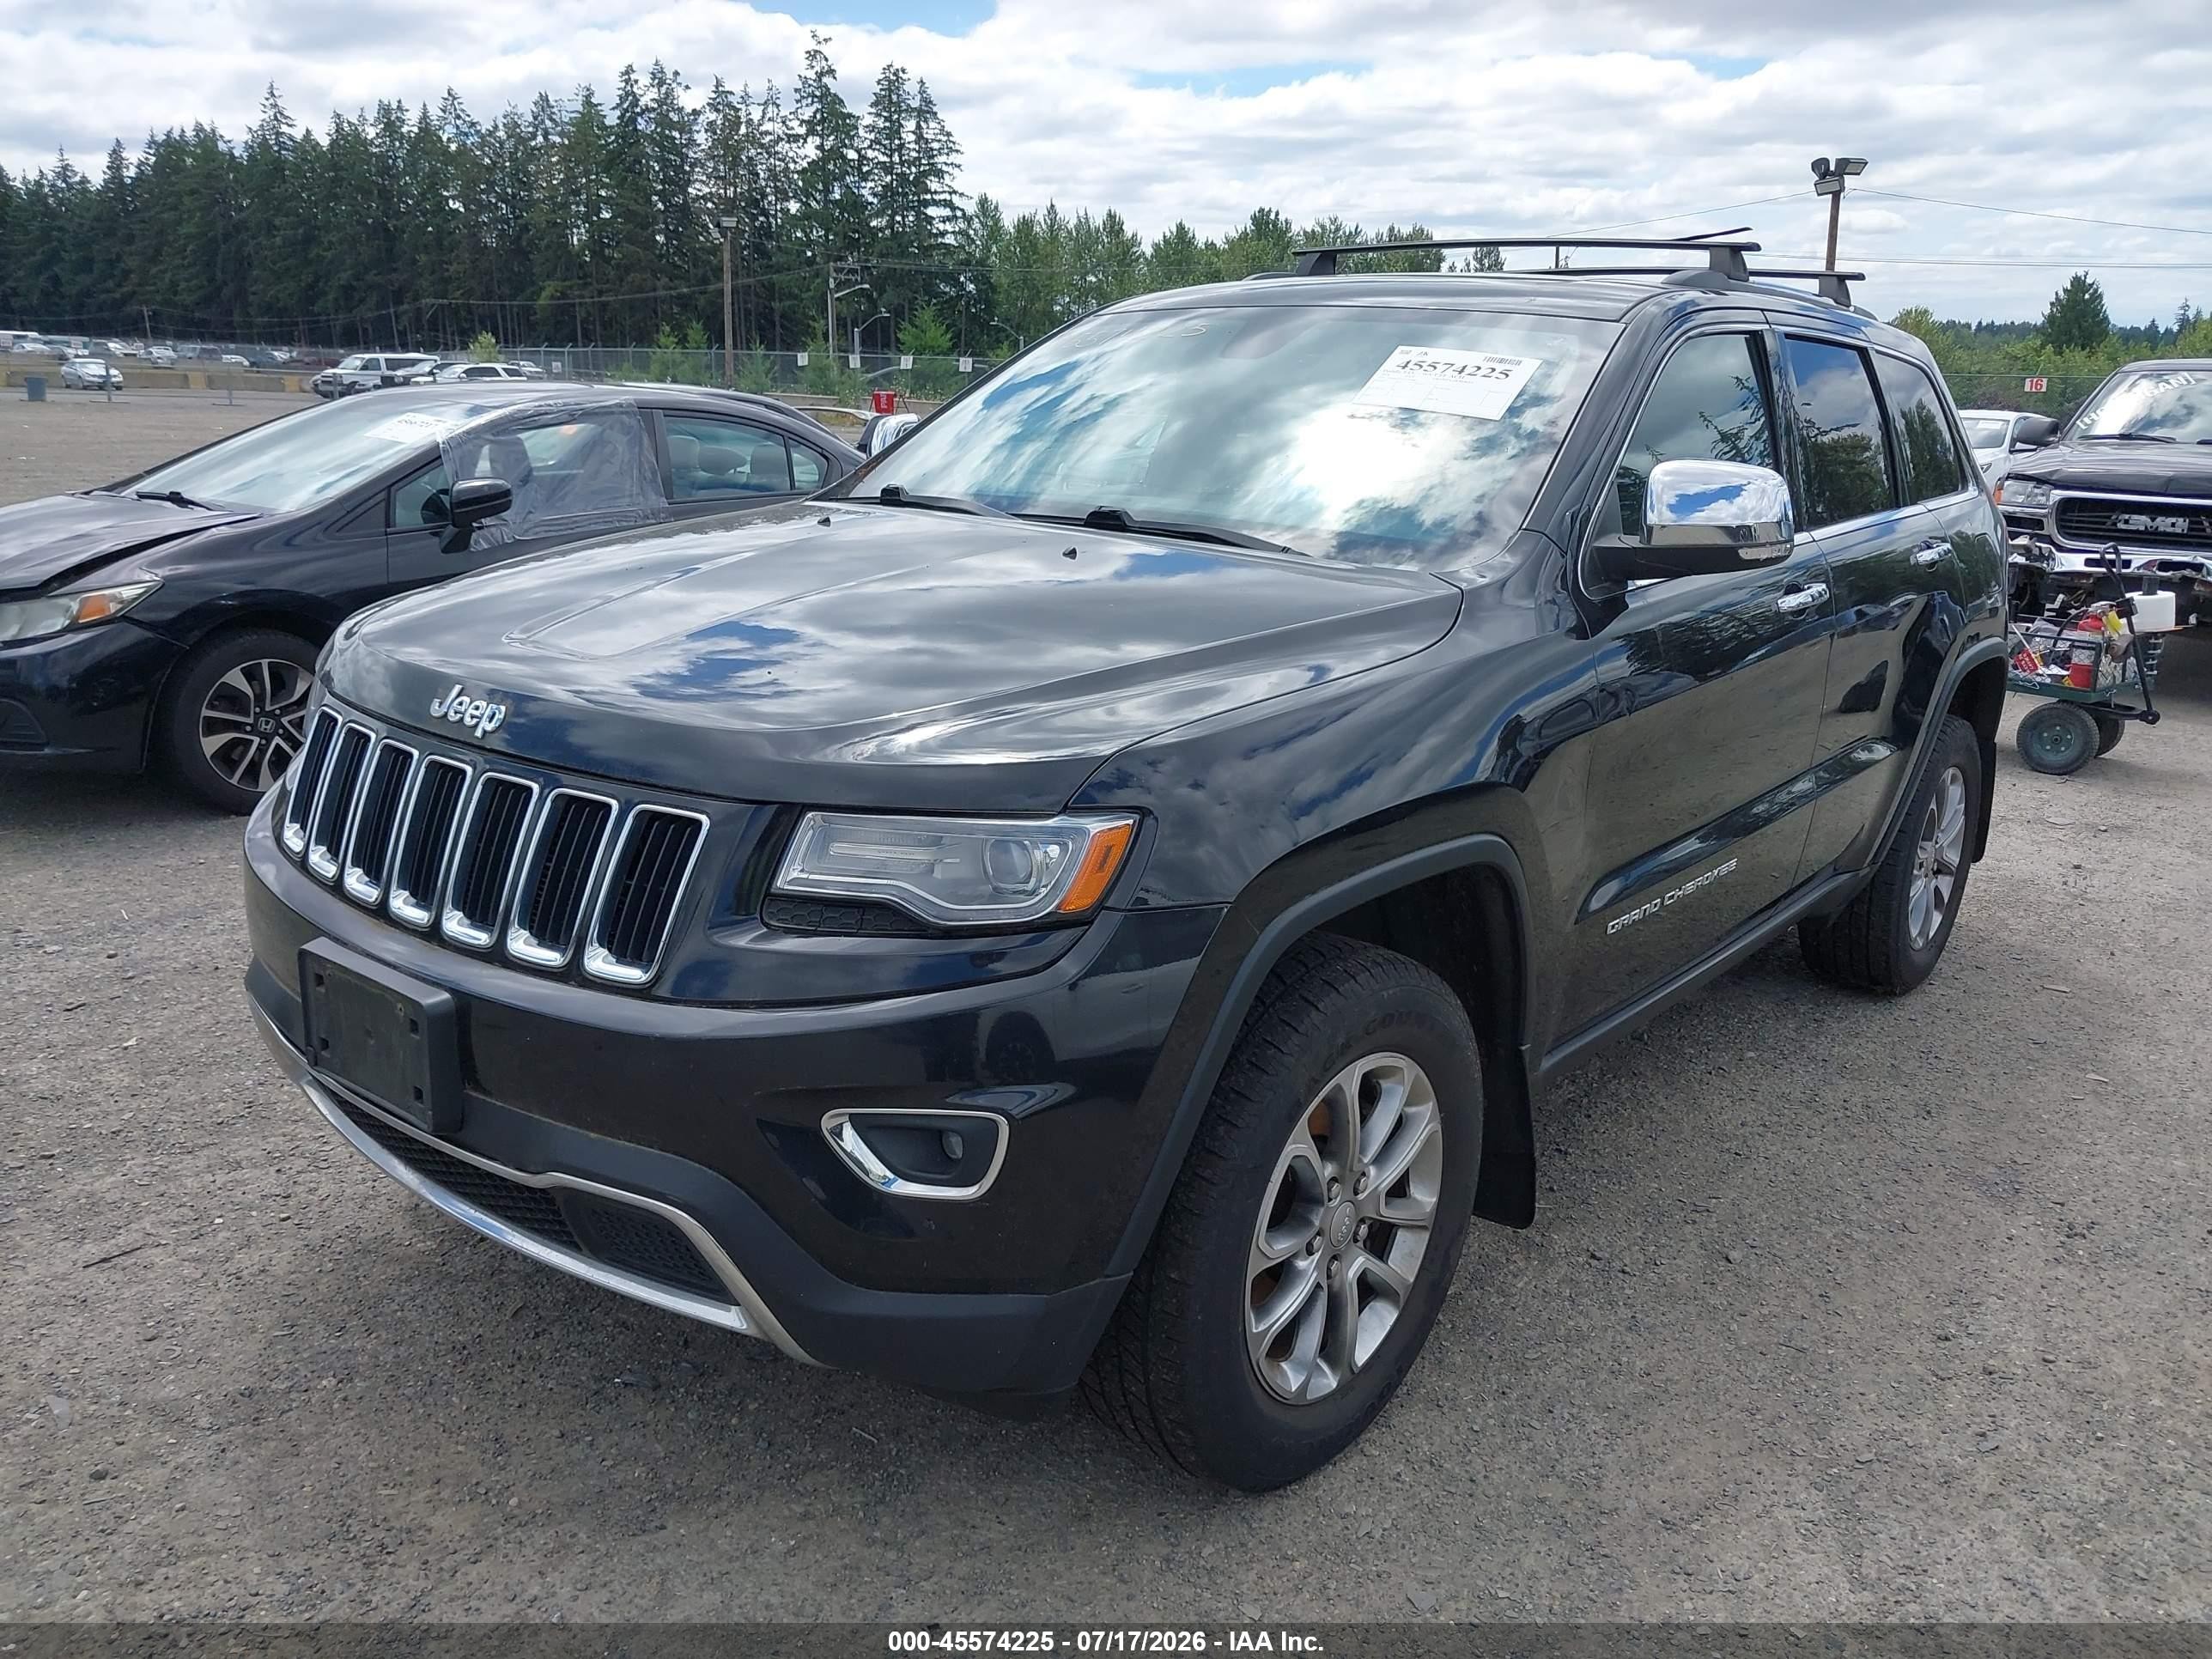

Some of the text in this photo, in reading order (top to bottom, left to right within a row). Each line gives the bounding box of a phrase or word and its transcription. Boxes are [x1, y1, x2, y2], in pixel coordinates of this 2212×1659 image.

[1397, 359, 1513, 380] 45574225
[2028, 379, 2044, 391] 16
[430, 684, 506, 738] Jeep
[1607, 858, 1738, 934] GRAND CHEROKEE
